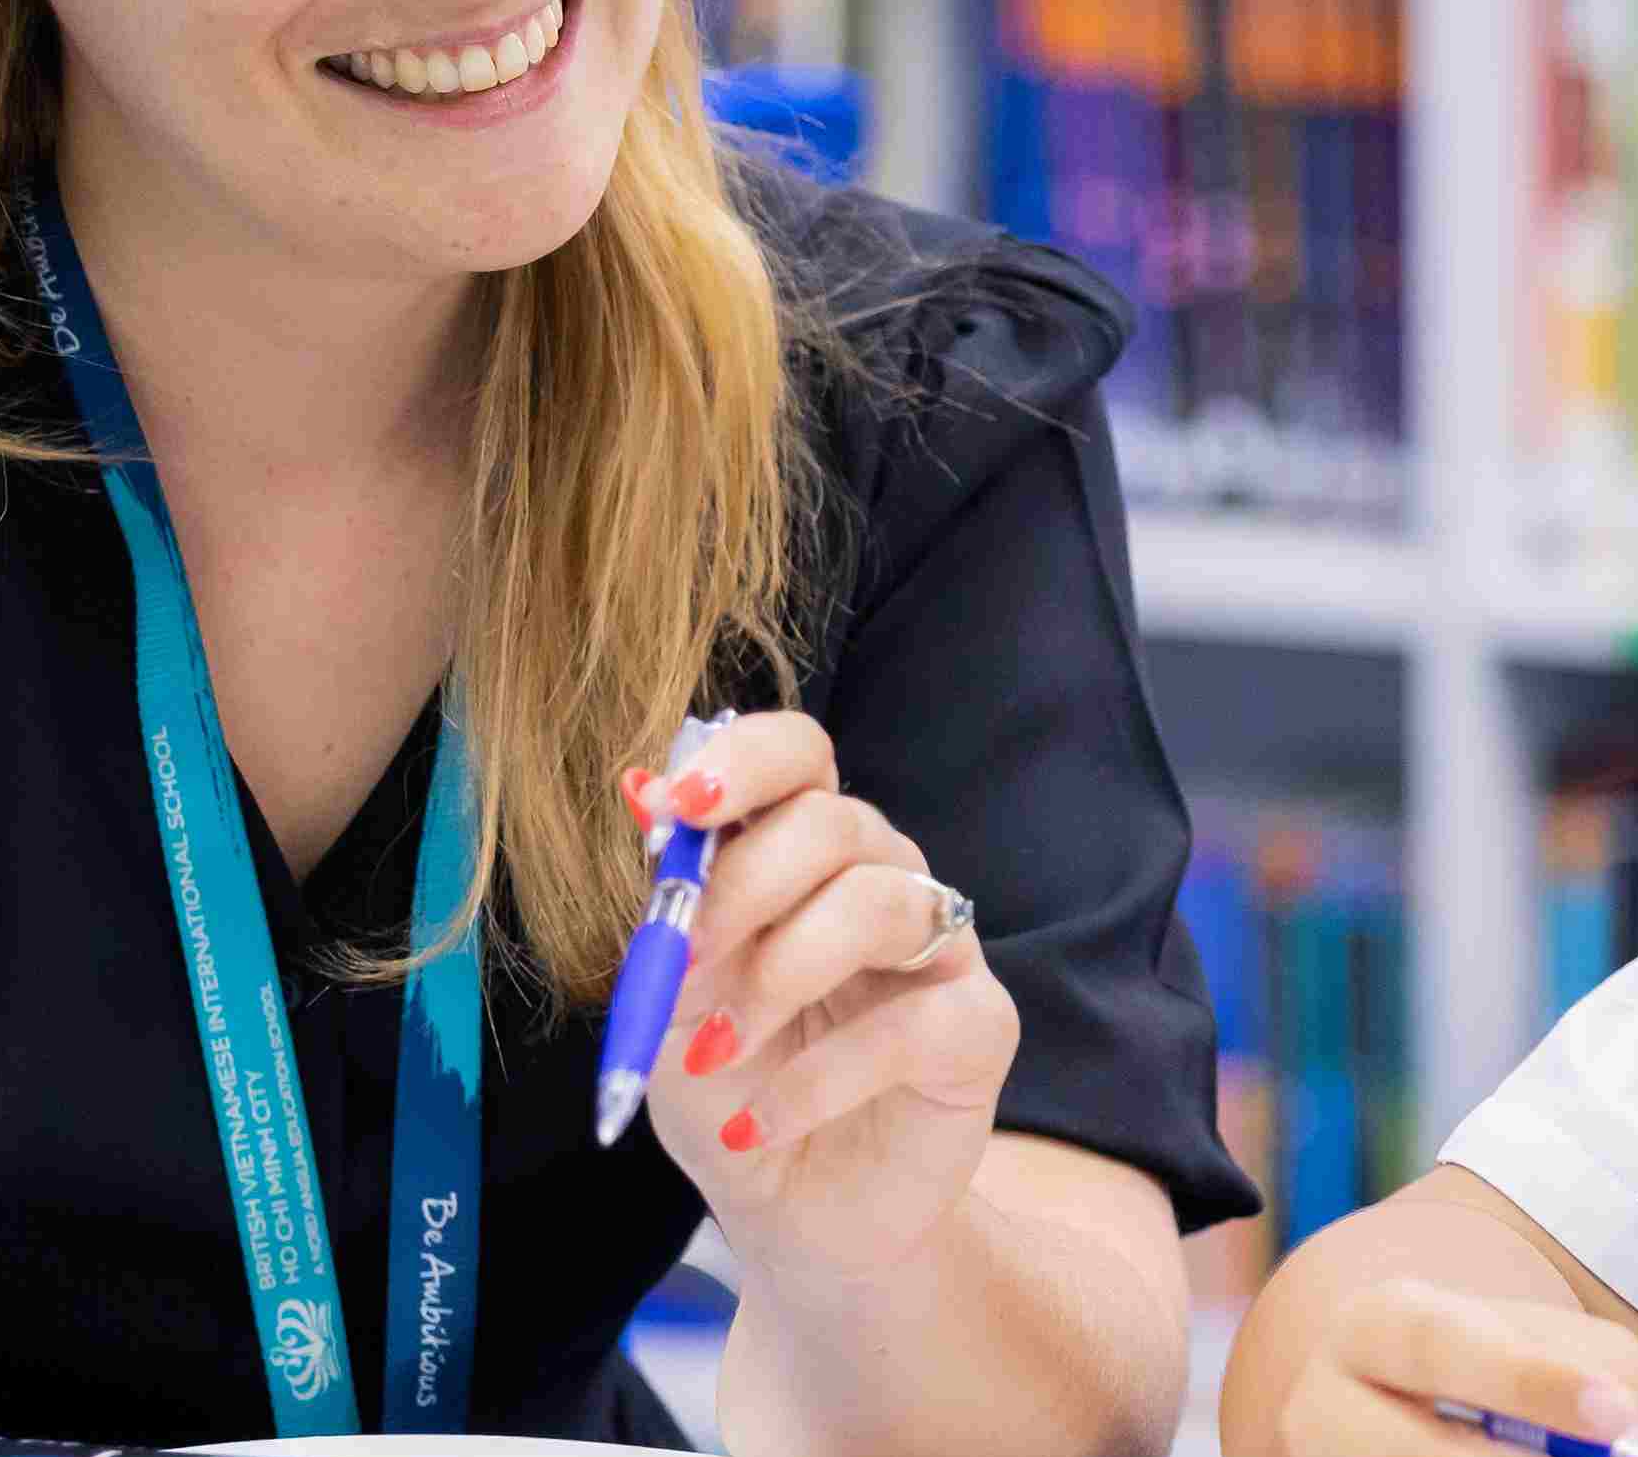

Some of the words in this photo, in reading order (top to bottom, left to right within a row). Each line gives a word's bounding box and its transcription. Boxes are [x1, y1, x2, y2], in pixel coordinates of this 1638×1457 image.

[152, 725, 186, 830] SCHOOL
[172, 831, 227, 1032] INTERNATIONAL
[259, 979, 284, 1050] SCHOOL
[211, 1036, 259, 1197] VIETNAMESE
[245, 1070, 272, 1124] CITY
[273, 1051, 303, 1148] EDUCATION
[259, 1127, 287, 1198] MINH
[244, 1198, 277, 1291] BRITISH
[271, 1199, 294, 1242] CHI
[421, 1192, 458, 1248] Be
[280, 1246, 300, 1285] HO
[416, 1253, 456, 1407] Ambitious
